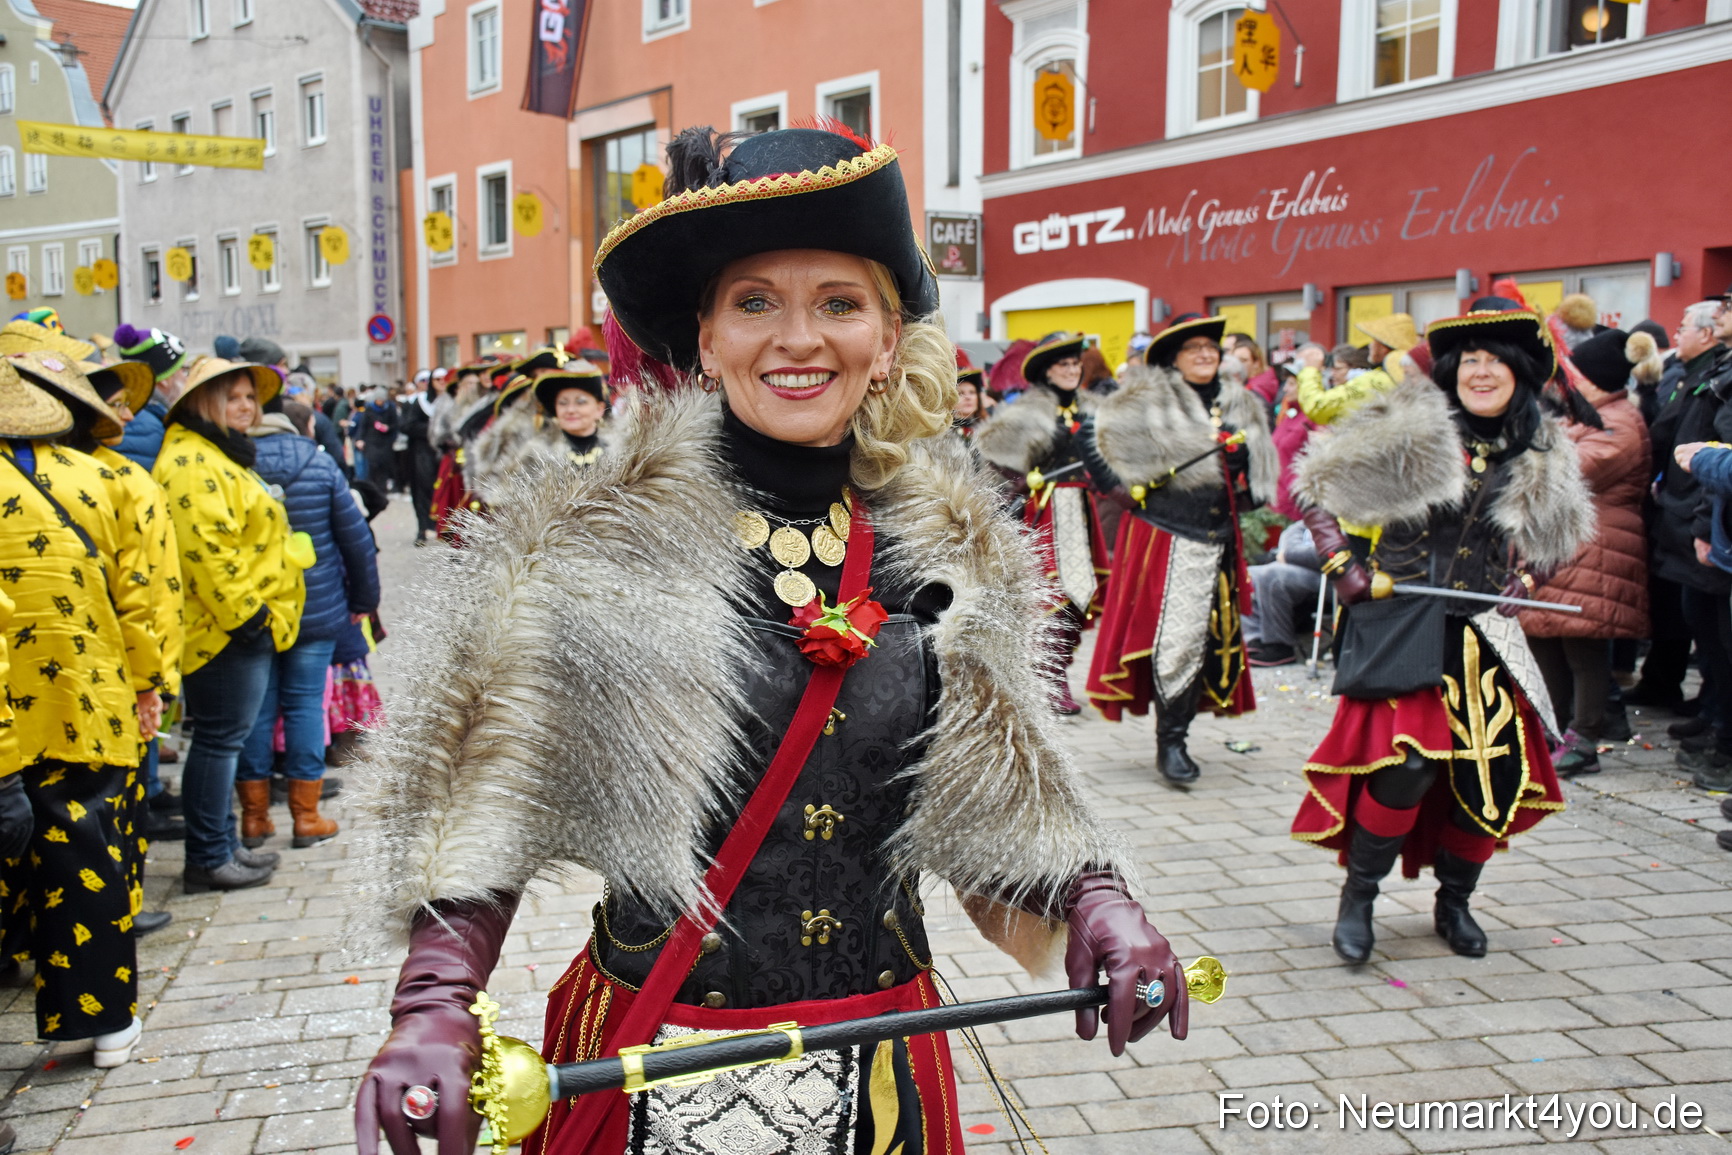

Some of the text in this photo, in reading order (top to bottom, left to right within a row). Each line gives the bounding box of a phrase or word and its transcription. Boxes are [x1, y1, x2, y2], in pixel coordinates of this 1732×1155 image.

[369, 97, 388, 314] UHREN SCHMUCK
[932, 219, 976, 245] CAFÉ
[1138, 188, 1198, 242] Mode
[1197, 199, 1260, 245] Genuss
[1265, 166, 1350, 222] Erlebnis
[1270, 205, 1384, 279] Genuss
[1399, 146, 1565, 241] Erlebnis
